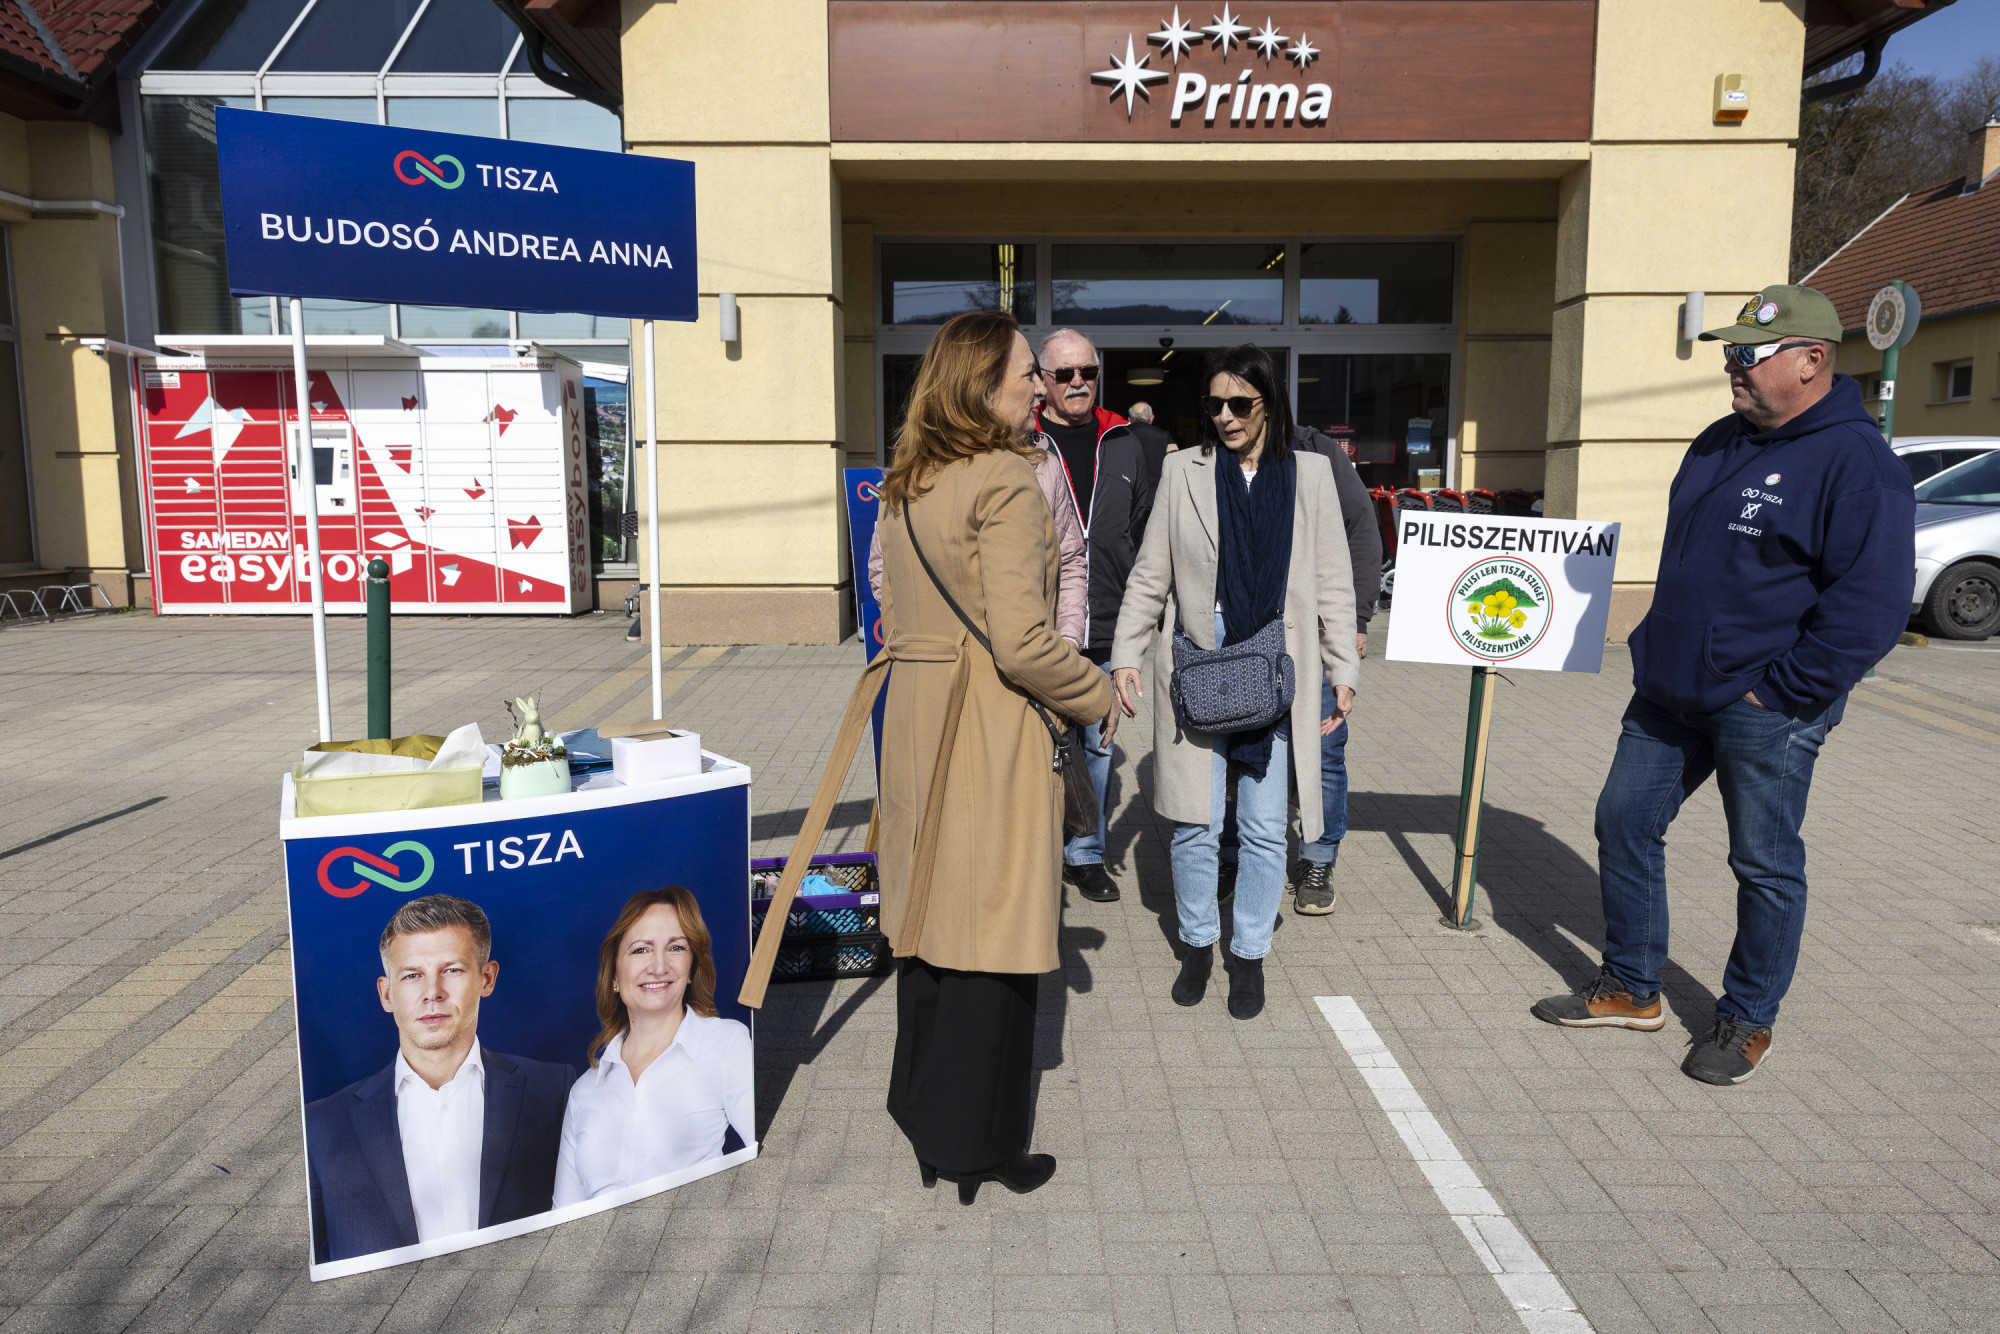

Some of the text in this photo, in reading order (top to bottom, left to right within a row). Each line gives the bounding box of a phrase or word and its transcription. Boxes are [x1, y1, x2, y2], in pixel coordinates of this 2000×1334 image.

[1170, 69, 1333, 121] Príma
[476, 164, 560, 194] TISZA
[260, 213, 673, 269] BUJDOSÓ ANDREA ANNA
[519, 361, 554, 369] Sameday
[570, 408, 586, 593] easybox
[1760, 492, 1783, 505] TISZA
[180, 531, 291, 549] SAMEDAY
[567, 493, 577, 592] SAMEDAY
[1403, 521, 1615, 556] PILISSZENTIVÁN
[1458, 564, 1545, 602] PILISI LEN TISZA SZIGET
[1461, 629, 1532, 653] PILISSZENTIVÁN
[453, 829, 585, 875] TISZA
